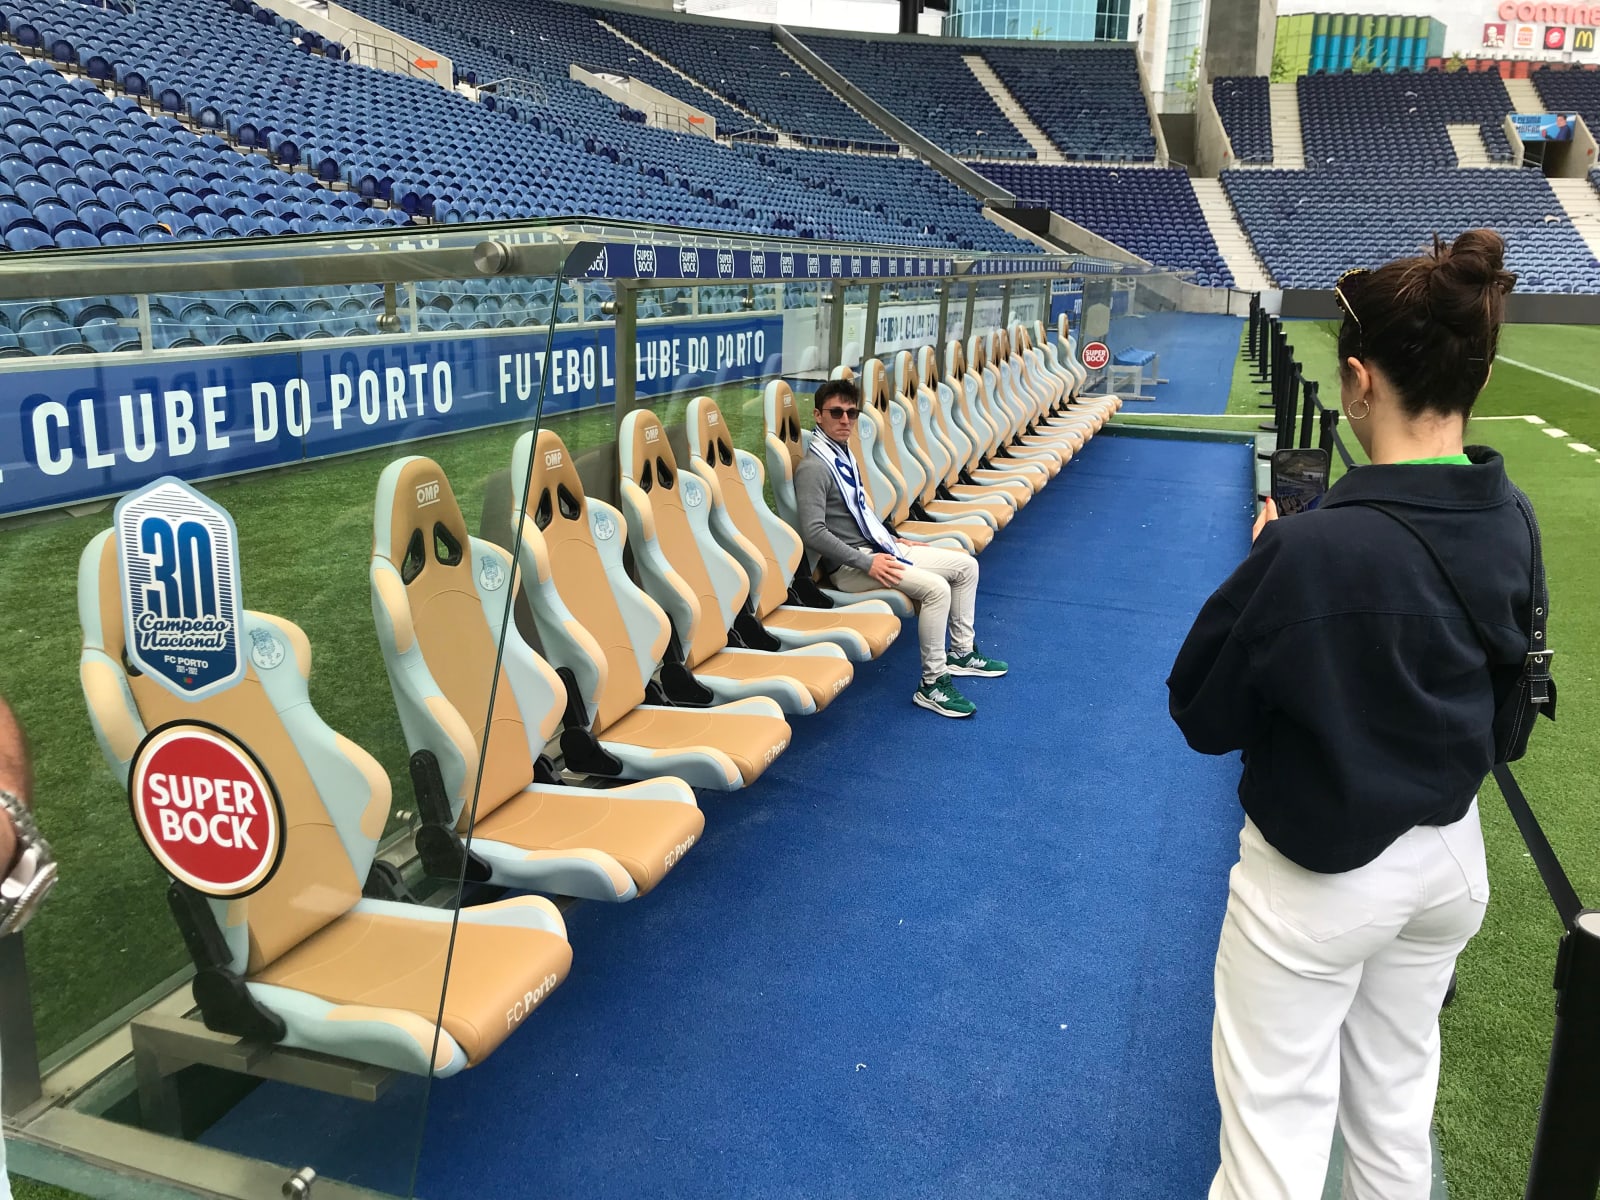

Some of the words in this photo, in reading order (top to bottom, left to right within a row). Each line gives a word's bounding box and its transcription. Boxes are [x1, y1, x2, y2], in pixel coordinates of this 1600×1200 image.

[637, 250, 653, 260] SUPER
[681, 252, 696, 262] SUPER
[639, 260, 653, 271] BOCK
[683, 262, 696, 272] BOCK
[499, 346, 614, 403] FUTEBOL
[635, 339, 680, 382] LUBE
[688, 336, 709, 374] DO
[717, 330, 764, 370] PORTO
[32, 386, 230, 475] CLUBE
[252, 378, 311, 443] DO
[330, 360, 453, 430] PORTO
[545, 452, 562, 466] OMP
[416, 484, 440, 503] OMP
[141, 517, 217, 620] 30
[138, 613, 228, 635] Campeão
[142, 631, 226, 649] Nacional
[164, 655, 176, 664] FC
[177, 657, 209, 669] PORTO
[148, 772, 258, 815] SUPER
[159, 808, 259, 850] BOCK
[664, 851, 675, 873] FC
[675, 834, 695, 859] Porto
[506, 1001, 523, 1030] FC
[523, 972, 557, 1012] Porto
